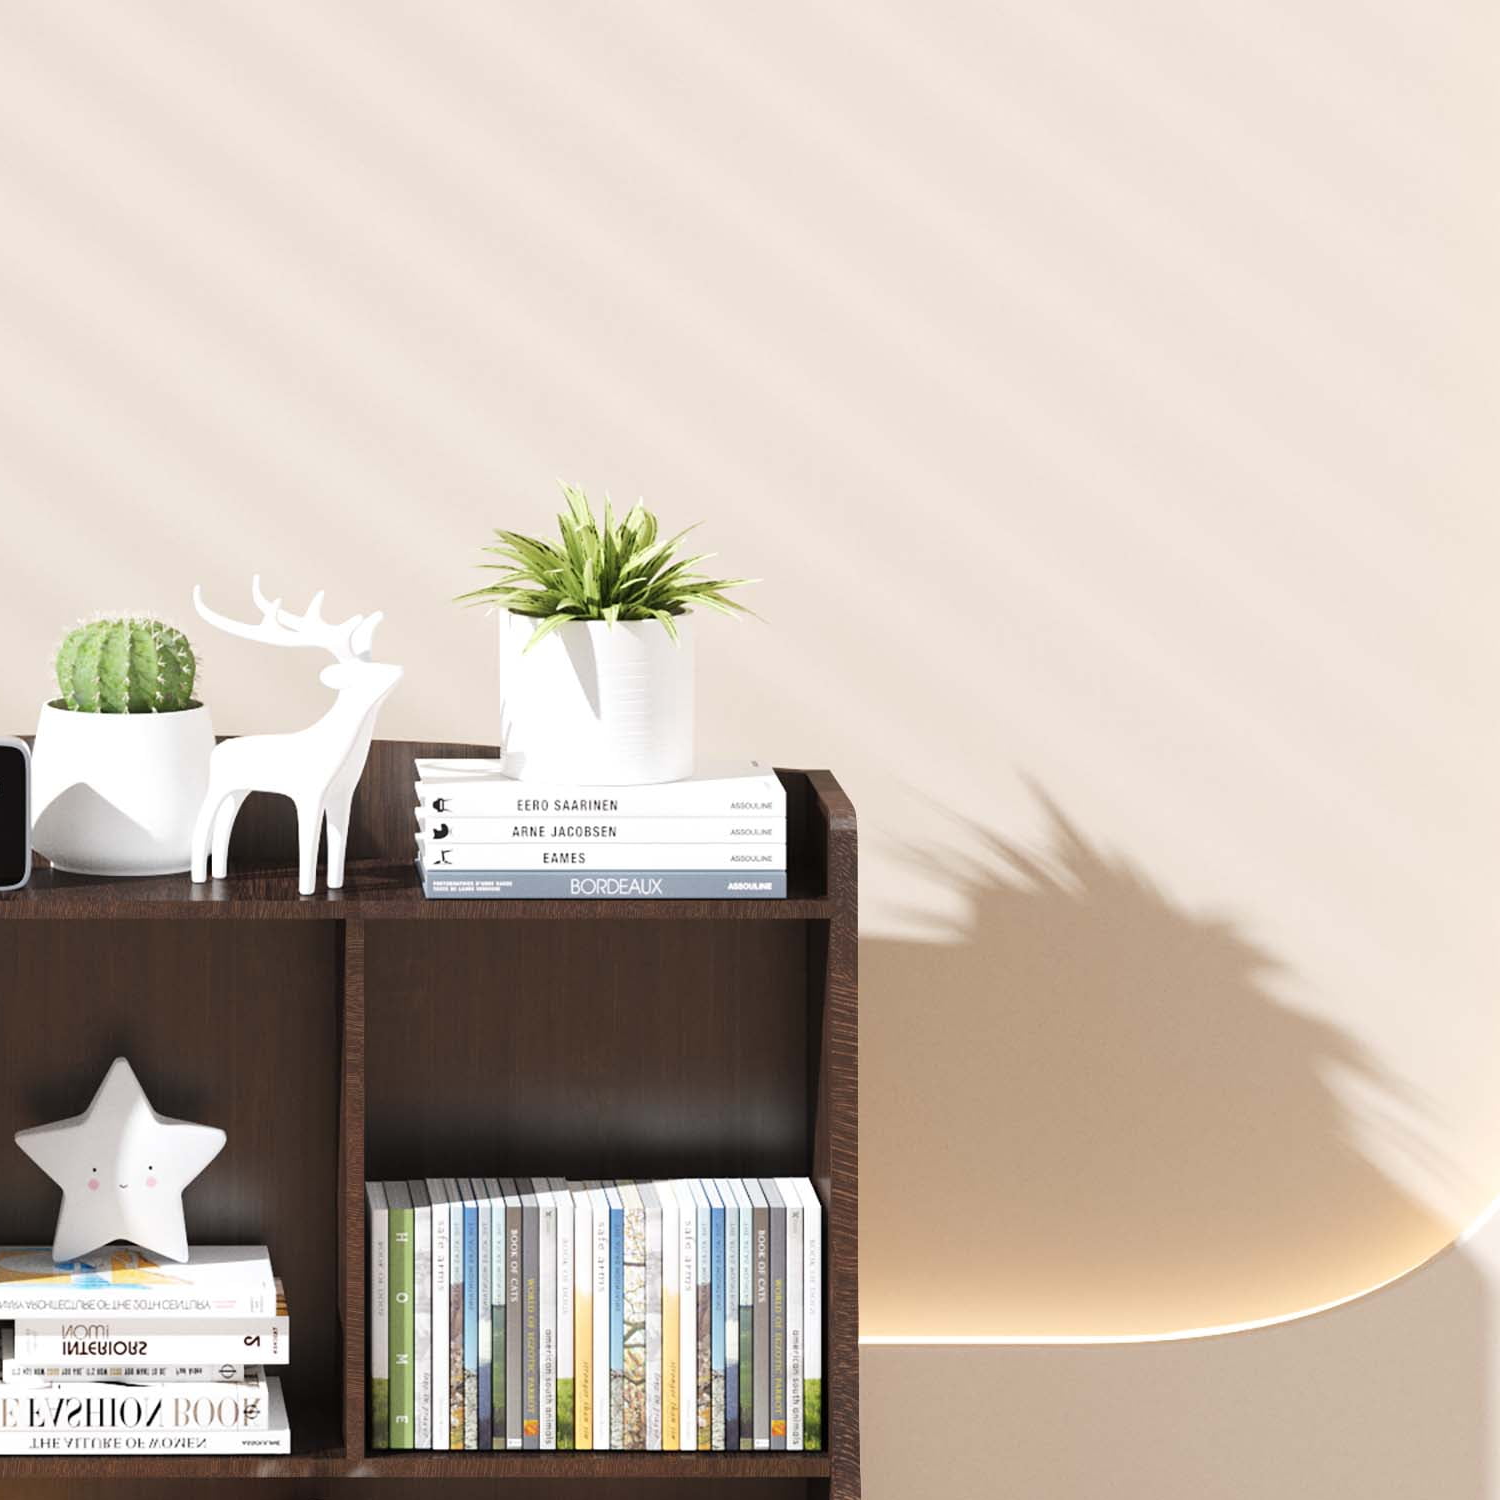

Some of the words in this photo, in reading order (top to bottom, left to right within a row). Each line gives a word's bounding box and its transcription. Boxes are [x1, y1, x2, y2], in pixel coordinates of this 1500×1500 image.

[517, 799, 549, 811] EERO
[554, 799, 618, 811] SAARINEN
[512, 826, 546, 837] ARNE
[551, 826, 618, 837] JACOBSEN
[543, 852, 586, 864] EAMES
[570, 878, 663, 896] BORDEAUX
[727, 882, 773, 891] ASSOULINE
[395, 1232, 409, 1424] HOME
